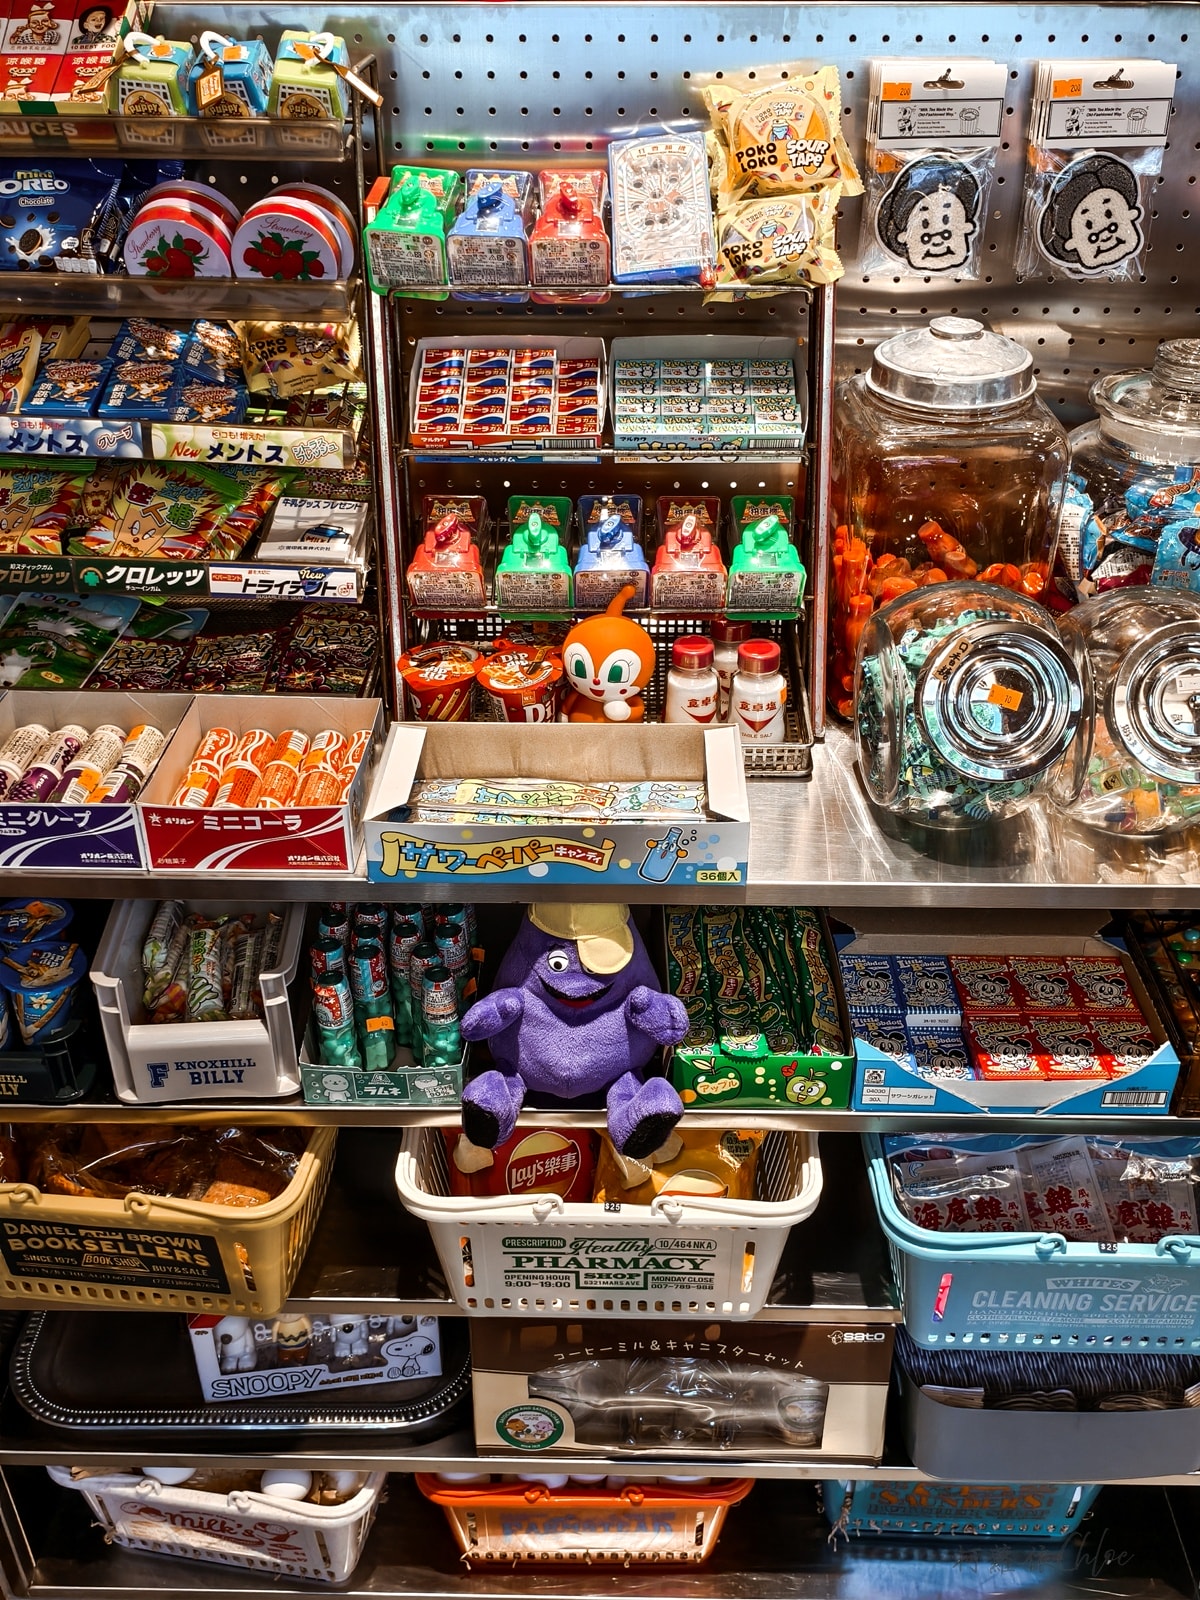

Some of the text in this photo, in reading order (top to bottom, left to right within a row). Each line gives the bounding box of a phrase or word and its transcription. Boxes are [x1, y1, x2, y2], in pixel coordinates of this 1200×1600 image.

[900, 88, 911, 96] 200
[1070, 85, 1081, 93] 200
[736, 142, 777, 162] POKO
[786, 139, 830, 155] SOUR
[740, 154, 778, 174] LOKO
[16, 171, 53, 180] mini
[0, 179, 68, 194] OREO
[260, 216, 314, 240] Strawberry
[773, 232, 812, 246] SOUR
[722, 241, 763, 259] POKO
[728, 249, 763, 268] LOKO
[51, 364, 96, 377] POPPING
[60, 370, 89, 379] CANDY
[120, 365, 166, 380] POPPING
[131, 371, 160, 380] CANDY
[184, 389, 232, 401] POPPING
[197, 394, 225, 402] CANDY
[6, 432, 84, 452] メントス
[97, 425, 133, 450] グレープ
[240, 431, 266, 441] 増えた!
[170, 441, 284, 463] New メントス
[282, 499, 362, 510] 牛乳グッズ プレゼント
[0, 570, 70, 585] クロレッツ
[105, 565, 205, 586] クロレッツ
[300, 570, 326, 580] New
[242, 578, 337, 596] トライデント
[502, 651, 529, 663] Dip
[937, 641, 969, 681] 口香糖
[739, 701, 777, 712] 食卓塩
[0, 810, 91, 828] ミニグレープ
[164, 814, 303, 831] オリオン ミニコーラ
[400, 840, 604, 871] サワーペーパー キャンディ
[700, 871, 739, 882] 36個入
[41, 952, 65, 962] Dip
[956, 961, 1001, 973] Bobdog
[1013, 961, 1059, 973] Bobdog
[1071, 961, 1117, 973] Bobdog
[976, 1021, 1021, 1035] Bobdog
[909, 1034, 933, 1045] Little
[174, 1058, 256, 1071] KNOXHILL
[147, 1062, 169, 1088] F
[189, 1069, 245, 1085] BILLY
[363, 1086, 402, 1096] ラムネ
[699, 1078, 738, 1093] アップル
[511, 1152, 578, 1189] Lay's 樂事
[1077, 1188, 1093, 1209] 風味
[603, 1202, 621, 1212] $25
[913, 1196, 1008, 1231] 海底雞
[1031, 1212, 1092, 1231] 紅燒魚
[1180, 1211, 1192, 1232] 風味
[3, 1222, 77, 1236] DANIEL
[127, 1233, 203, 1251] BROWN
[7, 1238, 212, 1267] BOOKSELLERS
[505, 1239, 656, 1256] PRESCRIPTION Healthy
[1100, 1243, 1118, 1252] $25
[23, 1254, 53, 1263] SINCE
[85, 1256, 113, 1266] BOOK
[114, 1257, 141, 1267] SHOP
[152, 1265, 208, 1276] BUY&SALE
[511, 1256, 710, 1271] PHARMACY
[583, 1272, 642, 1280] SHOP
[1051, 1278, 1135, 1290] WHITES
[972, 1290, 1199, 1312] CLEANING SERVICE
[843, 1332, 885, 1341] sato
[552, 1339, 805, 1370] コーヒーミル&キャニスターセット
[212, 1368, 322, 1398] SNOOPY
